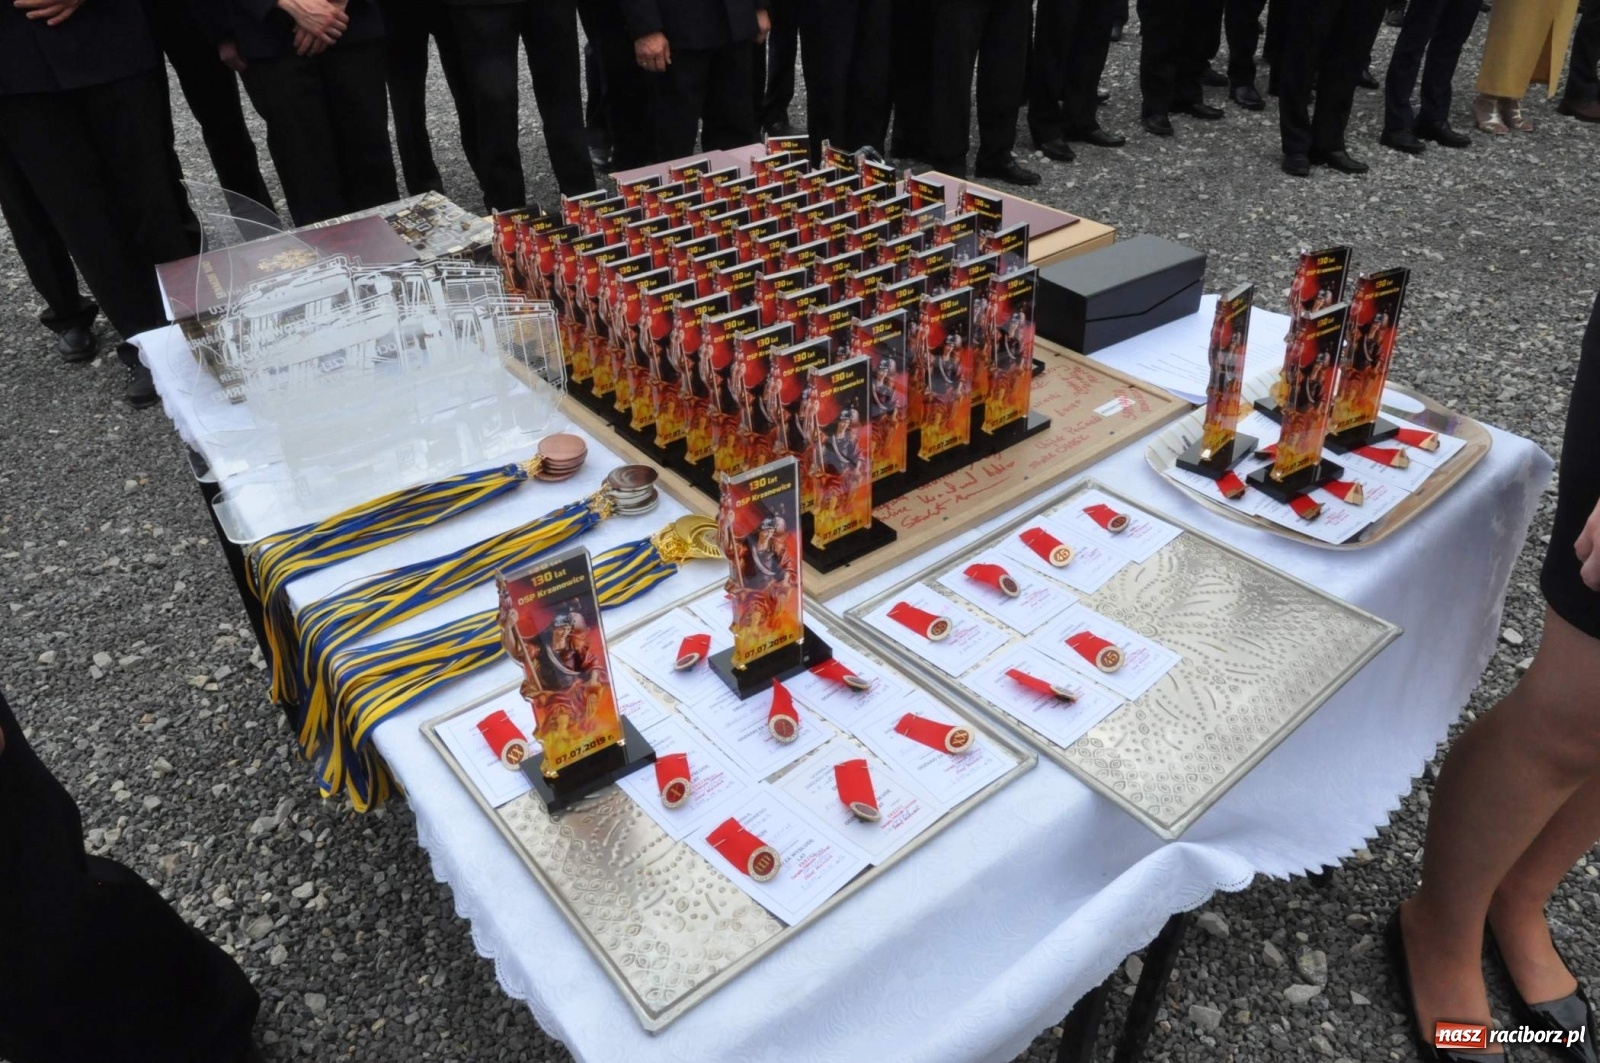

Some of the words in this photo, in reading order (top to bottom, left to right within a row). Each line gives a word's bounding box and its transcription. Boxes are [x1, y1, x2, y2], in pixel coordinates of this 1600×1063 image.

[862, 233, 872, 242] 130
[1002, 234, 1011, 244] 130
[769, 240, 780, 250] 130
[895, 244, 905, 254] 130
[798, 250, 809, 260] 130
[926, 256, 936, 265] 130
[1317, 256, 1329, 266] 130
[619, 265, 631, 274] 130
[832, 262, 843, 272] 130
[968, 266, 978, 275] 130
[732, 272, 743, 281] 130
[864, 276, 876, 286] 130
[774, 280, 786, 289] 130
[1008, 280, 1018, 290] 130
[1376, 280, 1386, 288] 130
[662, 293, 674, 302] 130
[896, 289, 907, 298] 130
[797, 297, 809, 307] 130
[940, 300, 952, 310] 130
[652, 306, 663, 315] OSP
[694, 306, 708, 315] 130
[829, 312, 841, 322] 130
[685, 320, 696, 328] OSP
[724, 320, 736, 330] 130
[1317, 318, 1328, 328] 130
[820, 326, 830, 335] OSP
[872, 324, 885, 334] 130
[757, 336, 770, 348] 130
[862, 340, 873, 348] OSP
[747, 352, 758, 361] OSP
[793, 351, 807, 363] 130
[783, 368, 794, 377] OSP
[831, 372, 846, 384] 130
[820, 388, 832, 398] OSP
[832, 378, 865, 394] Krzanowice
[748, 477, 767, 492] 130
[768, 476, 778, 485] lat
[736, 498, 750, 508] OSP
[752, 482, 792, 502] Krzanowice
[823, 520, 858, 540] 07.07.2019
[1055, 548, 1069, 562] 45
[531, 572, 553, 587] 130
[554, 568, 567, 578] lat
[518, 593, 536, 606] OSP
[537, 574, 585, 598] Krzanowice
[744, 634, 788, 659] 07.07.2019
[1101, 649, 1120, 667] 45
[555, 736, 607, 766] 07.07.2019
